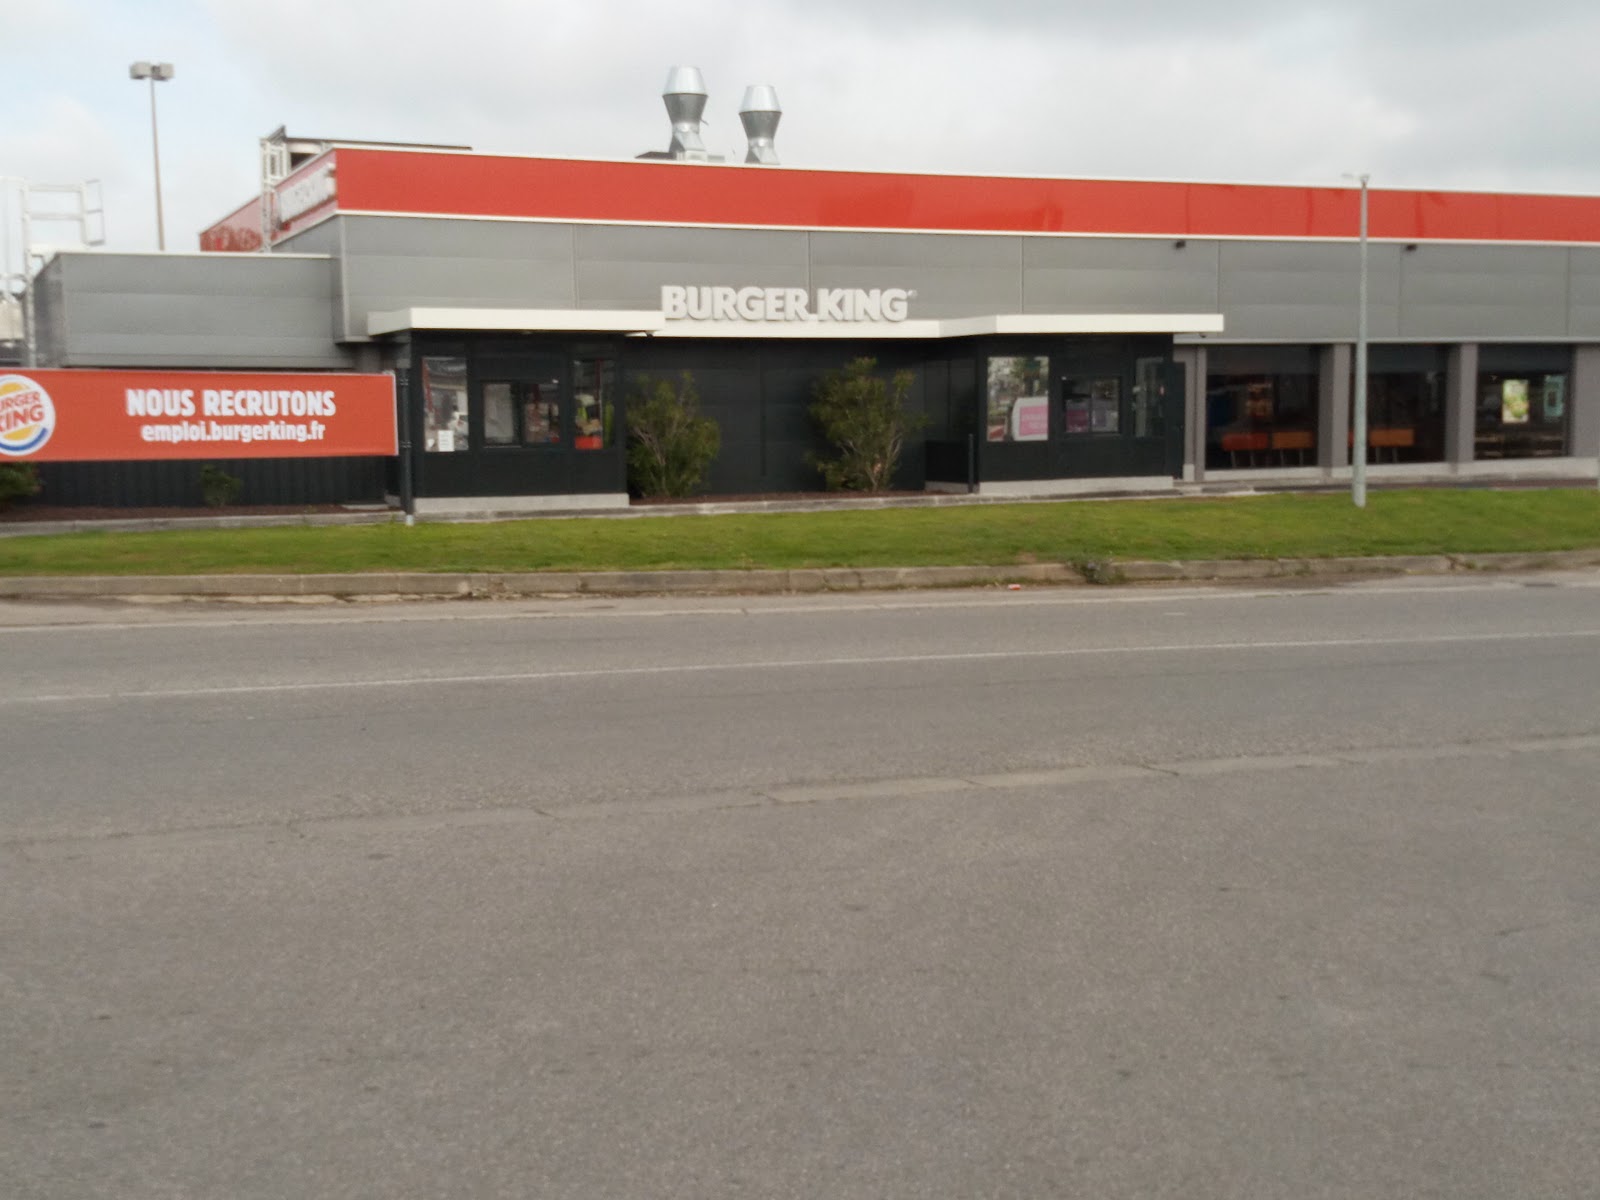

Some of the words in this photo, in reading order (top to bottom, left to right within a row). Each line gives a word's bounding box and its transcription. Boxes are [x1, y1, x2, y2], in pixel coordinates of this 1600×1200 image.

[661, 285, 808, 321] BURGER
[817, 288, 908, 321] KING
[126, 388, 196, 416] NOUS
[203, 390, 336, 416] RECRUTONS
[142, 420, 325, 443] emploi.burgerking.fr
